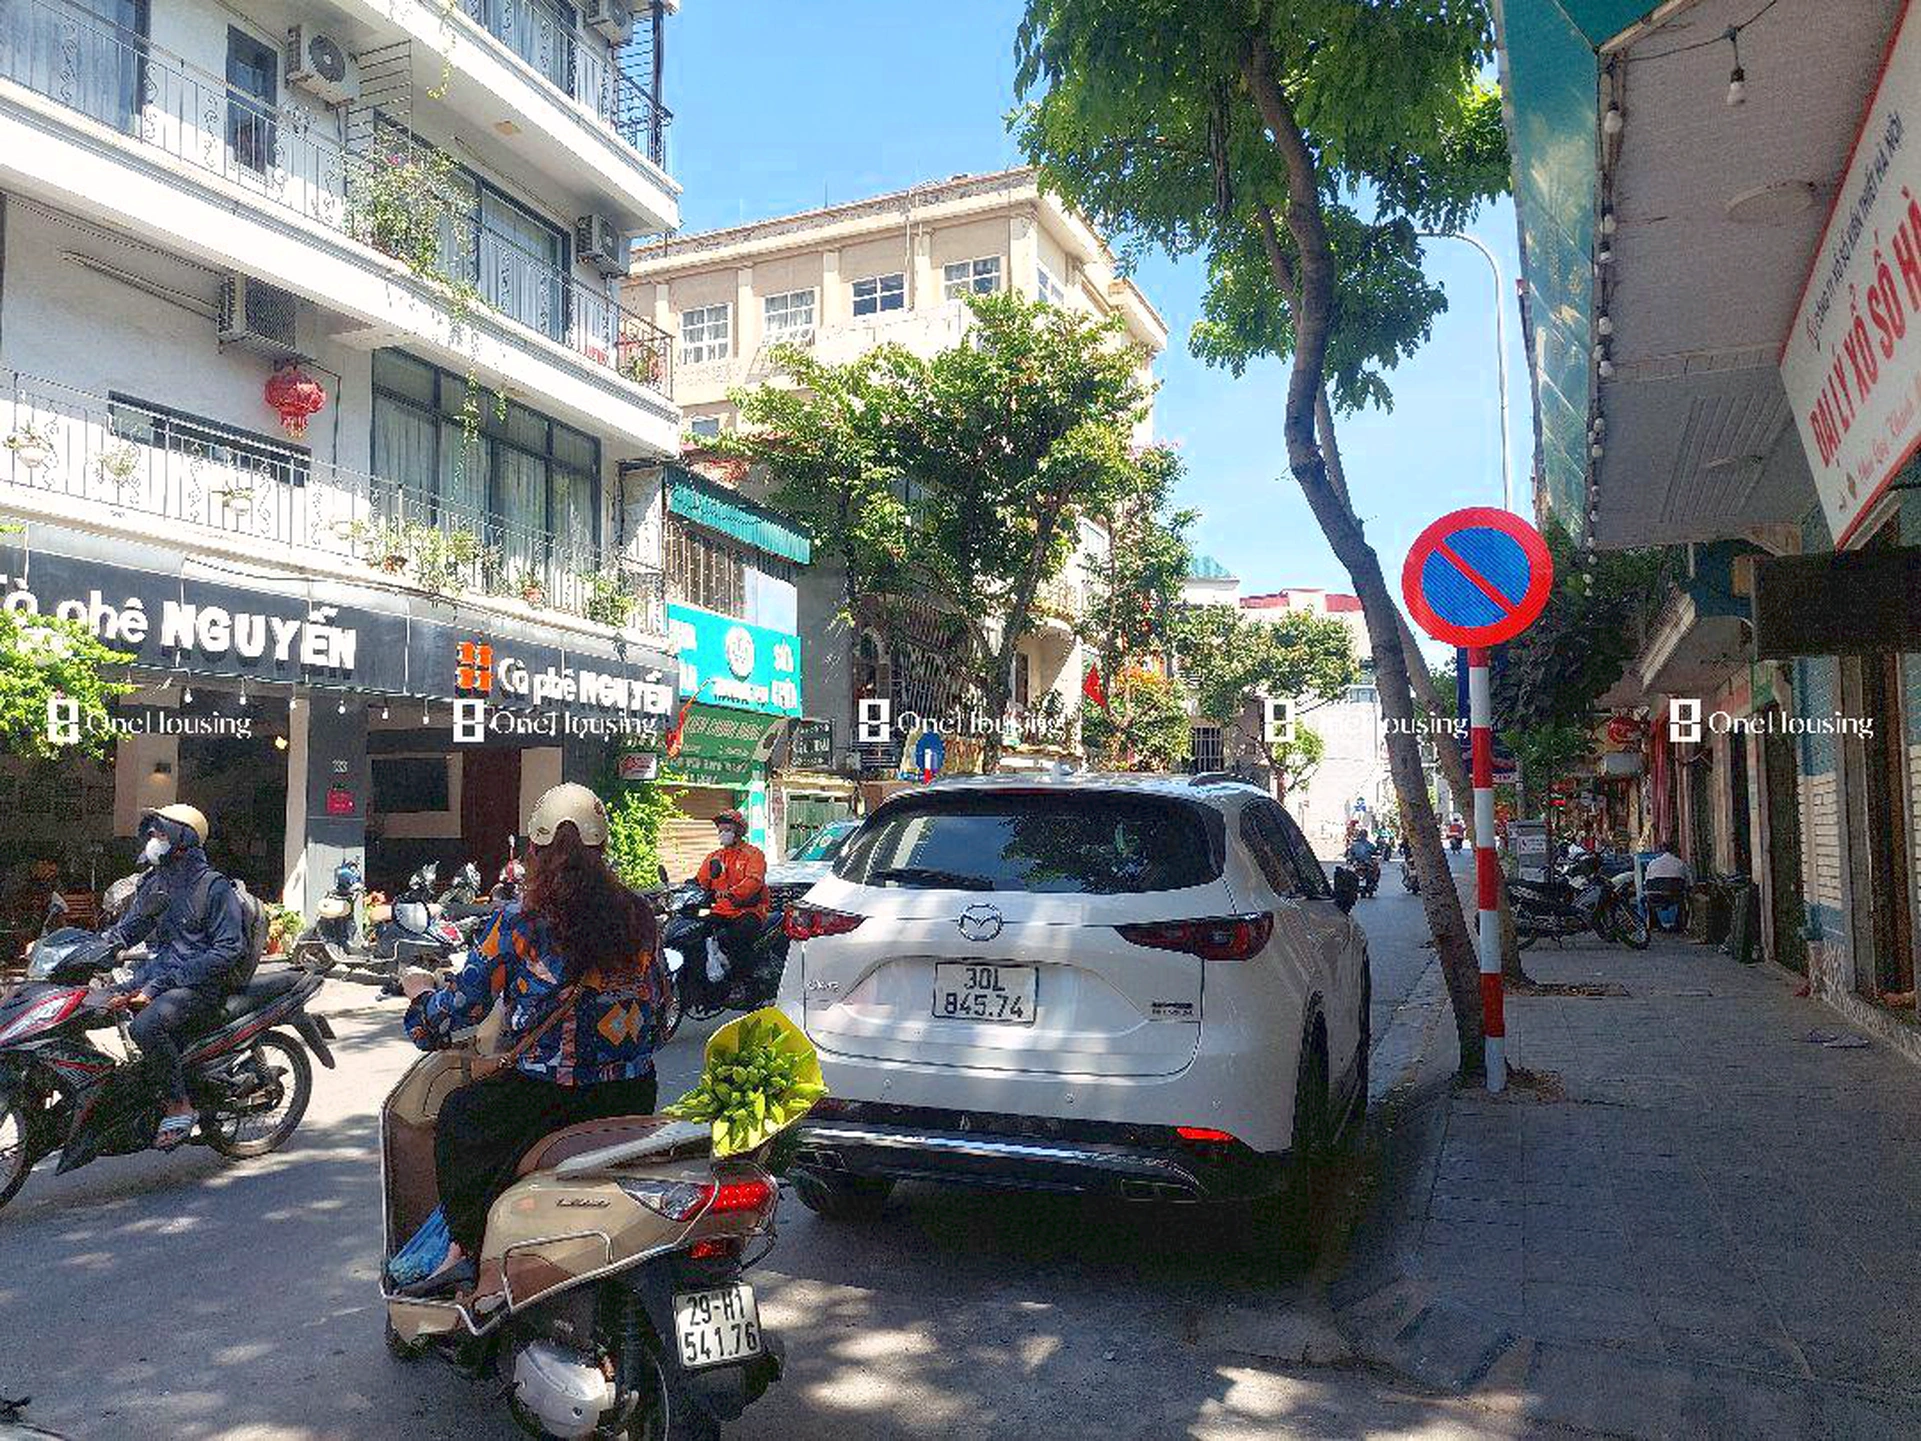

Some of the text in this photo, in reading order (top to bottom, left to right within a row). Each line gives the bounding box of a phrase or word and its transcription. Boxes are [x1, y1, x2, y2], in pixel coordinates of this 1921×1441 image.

[964, 967, 1006, 992] 30L
[944, 992, 1024, 1018] 845.74
[686, 1286, 745, 1326] 29-H1
[684, 1321, 757, 1362] 541.76
